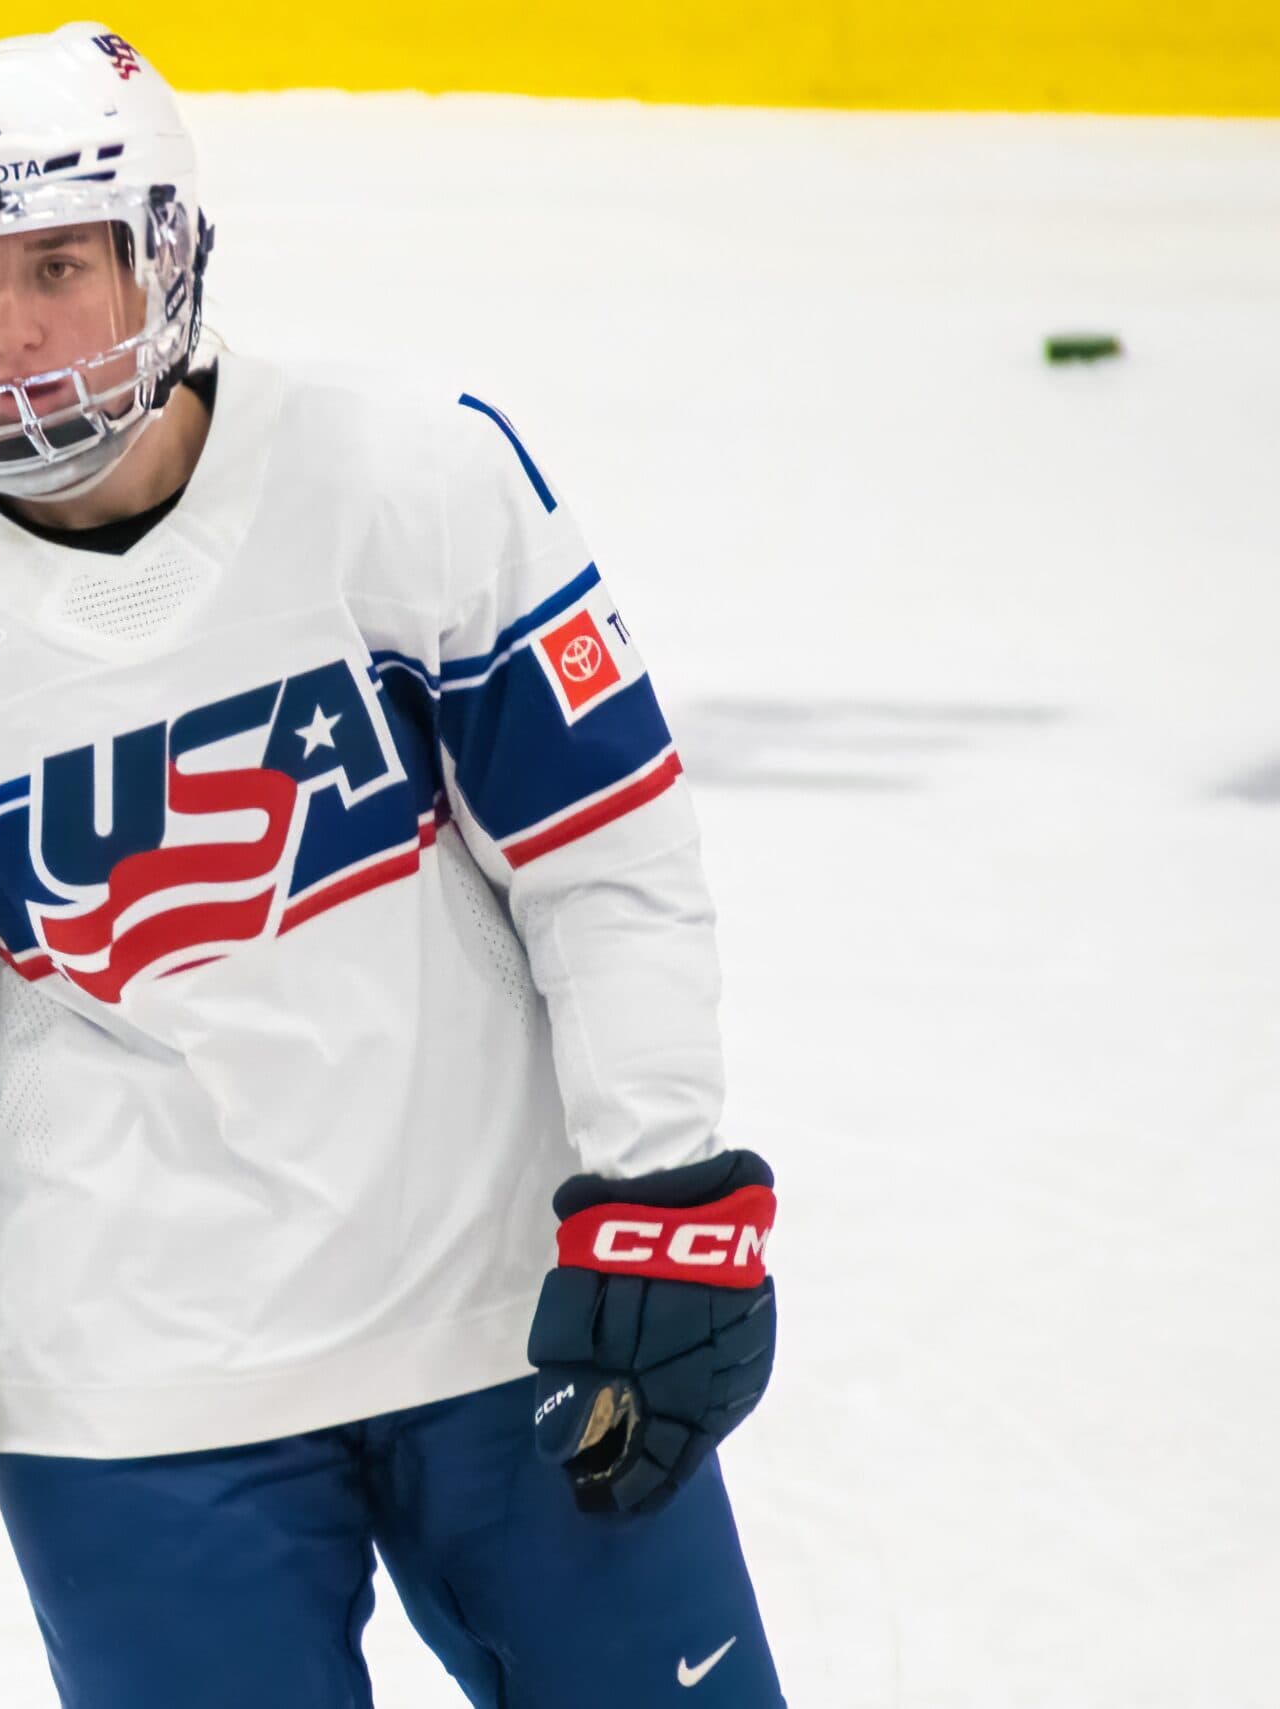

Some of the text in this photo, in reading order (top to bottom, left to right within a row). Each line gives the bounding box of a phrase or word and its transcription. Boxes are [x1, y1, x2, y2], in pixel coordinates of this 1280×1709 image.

[41, 658, 390, 1004] USA
[592, 1220, 771, 1268] CCM
[534, 1383, 576, 1425] CCM
